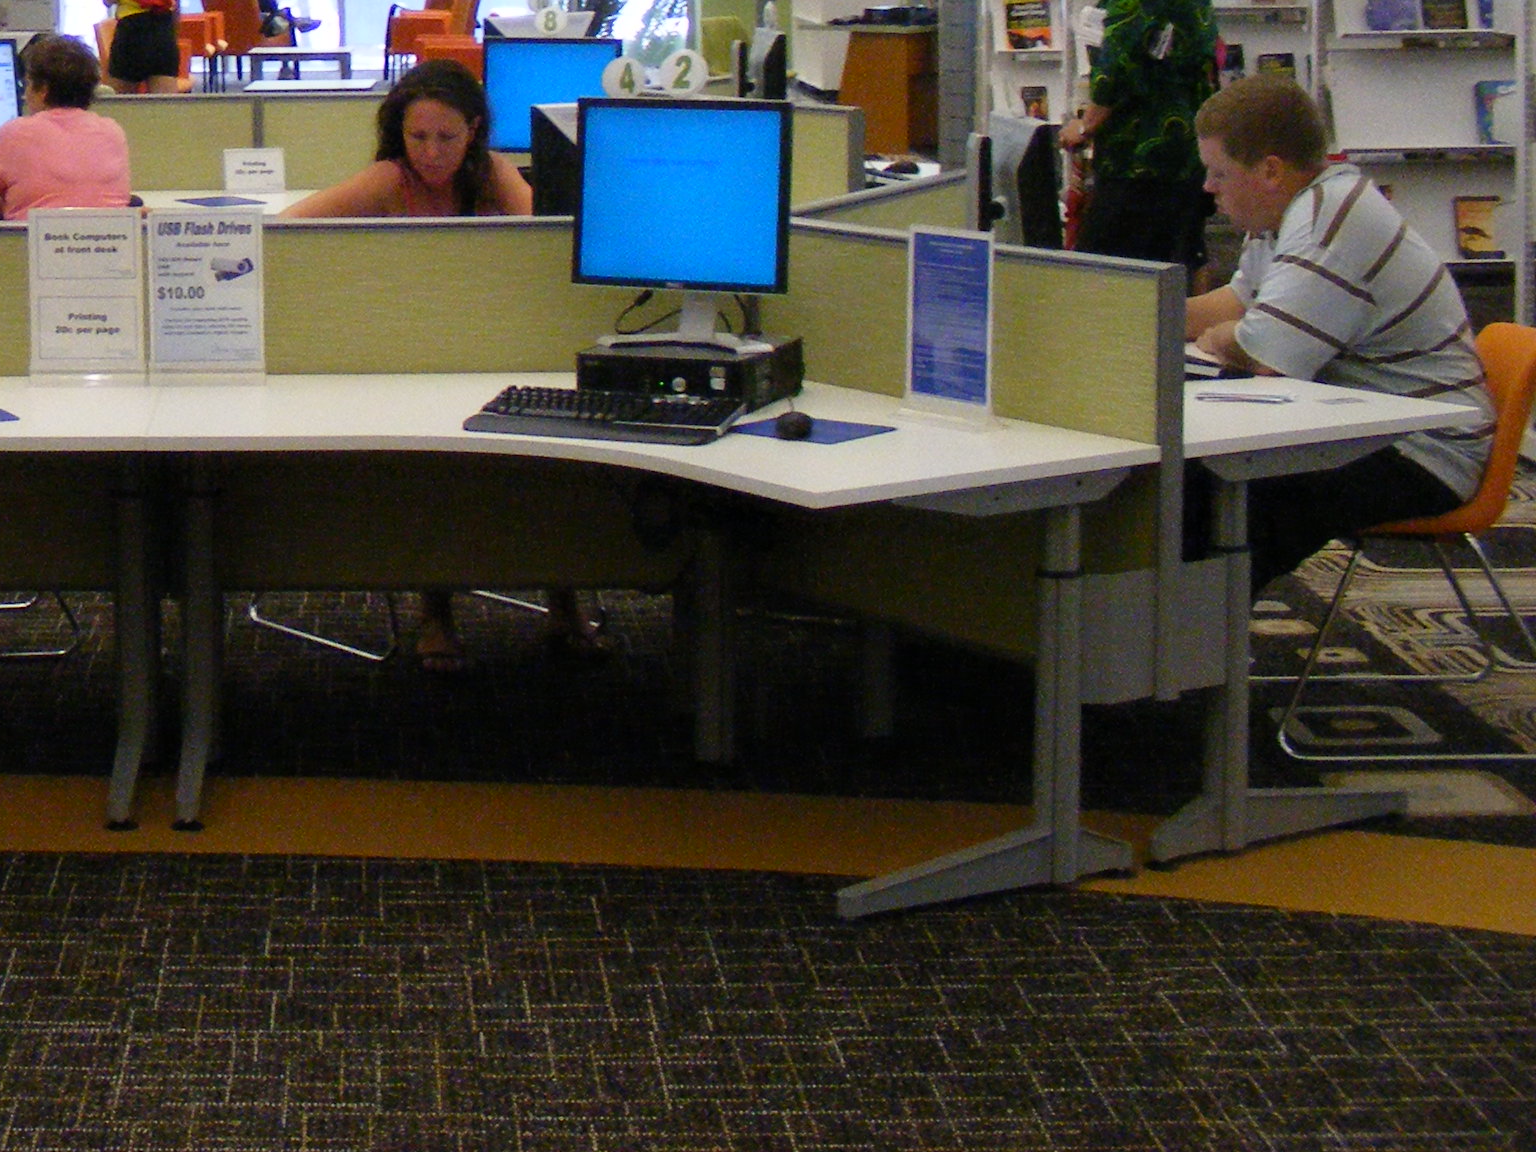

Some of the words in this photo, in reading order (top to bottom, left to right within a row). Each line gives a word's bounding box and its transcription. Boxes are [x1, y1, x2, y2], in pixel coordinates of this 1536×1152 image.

[544, 11, 557, 31] 8
[619, 63, 635, 93] 4
[672, 55, 691, 89] 2
[158, 222, 181, 236] USB
[184, 221, 214, 235] Flash
[217, 221, 252, 235] Drives
[157, 286, 205, 300] $10.00
[68, 312, 107, 322] Printing
